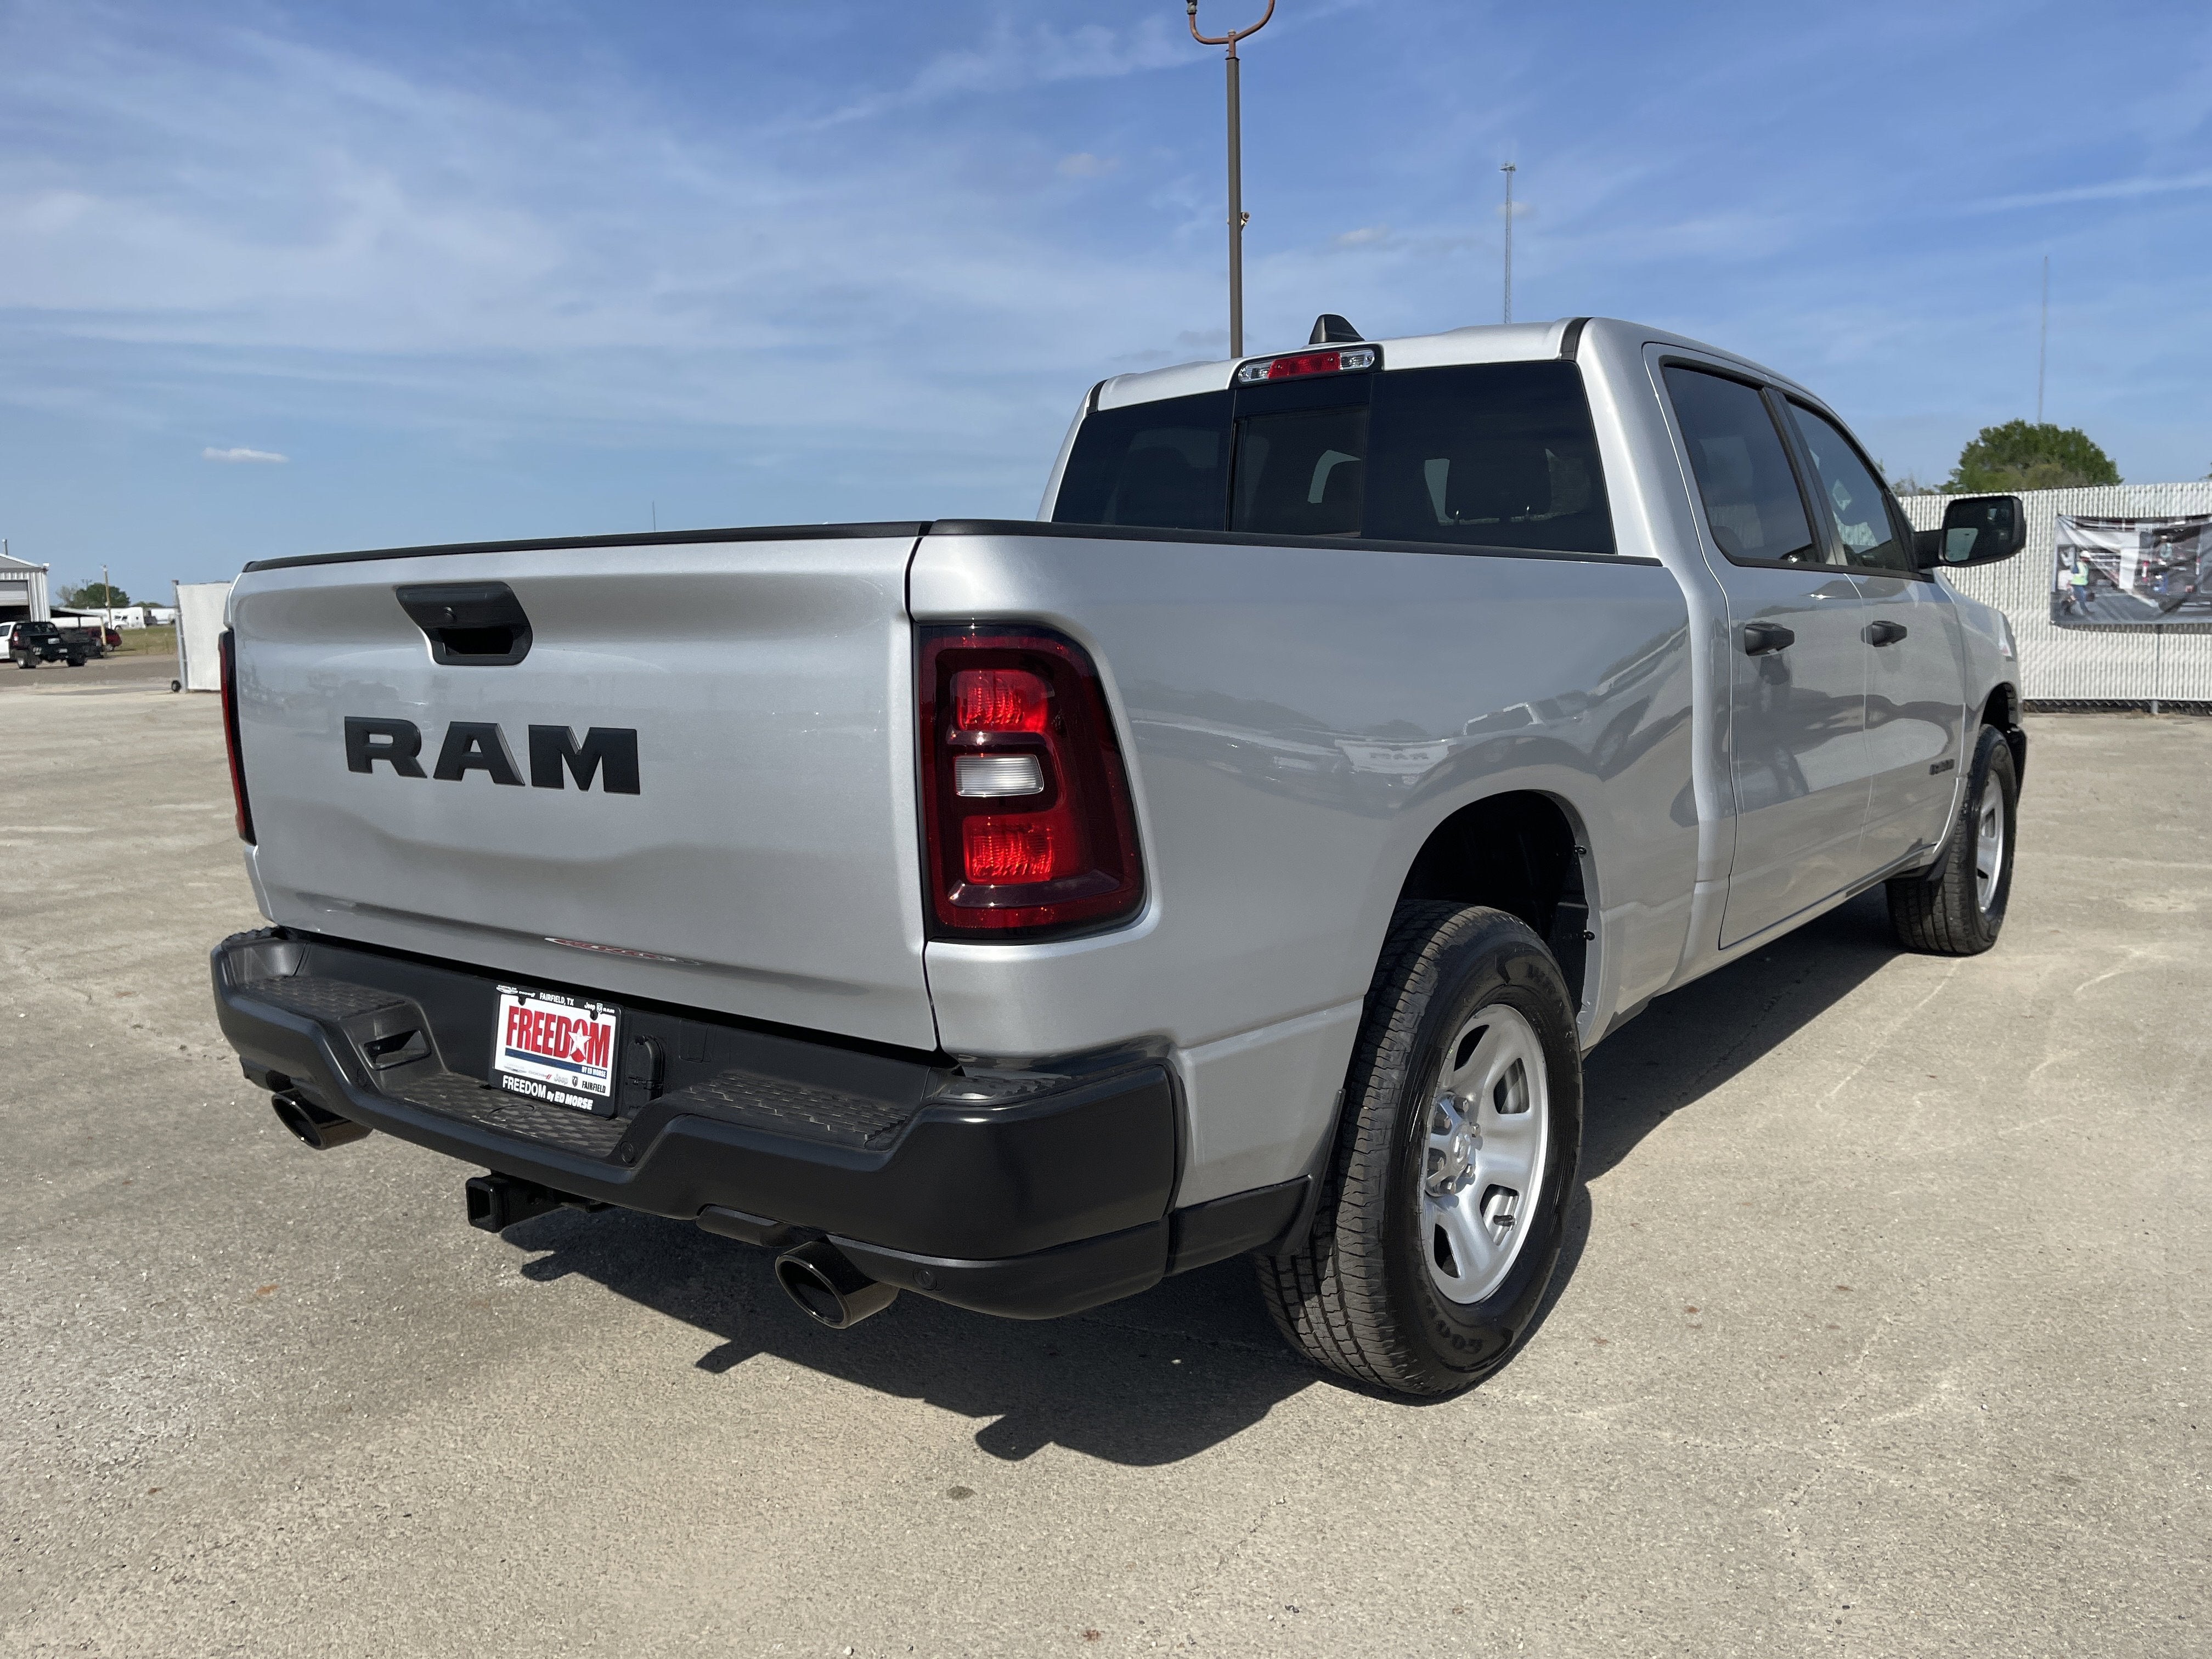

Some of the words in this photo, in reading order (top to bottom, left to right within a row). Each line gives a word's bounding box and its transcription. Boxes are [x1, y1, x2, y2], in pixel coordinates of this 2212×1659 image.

[344, 716, 640, 795] RAM
[539, 992, 566, 1005] FAIRFIELD,
[566, 997, 574, 1006] TX
[584, 1002, 596, 1011] Jeep
[506, 1005, 611, 1068] FREEDOM
[554, 1074, 569, 1085] Jeep
[592, 1068, 606, 1078] MORSE
[503, 1075, 546, 1099] FREEDOM
[554, 1091, 565, 1103] ED
[565, 1093, 594, 1110] MORSE
[582, 1080, 606, 1093] FAIRFIELD
